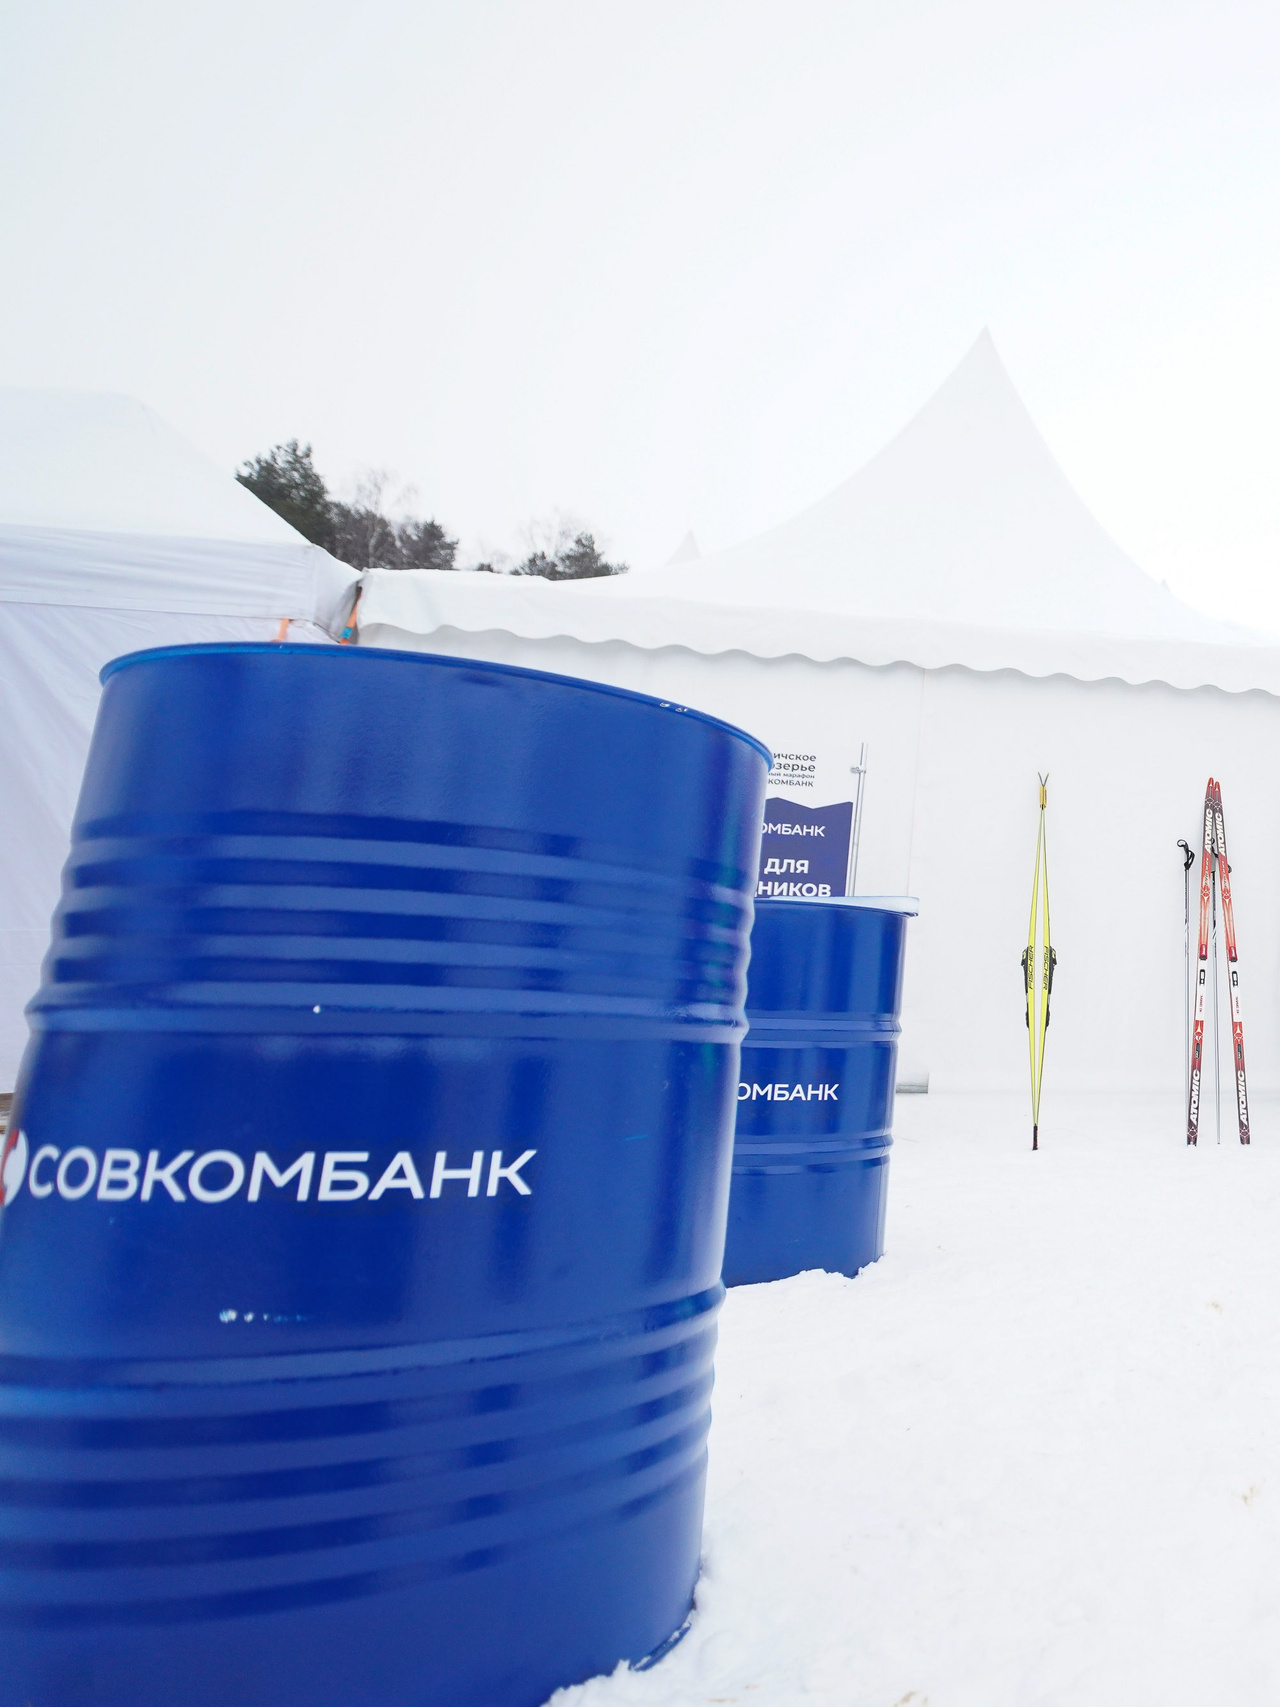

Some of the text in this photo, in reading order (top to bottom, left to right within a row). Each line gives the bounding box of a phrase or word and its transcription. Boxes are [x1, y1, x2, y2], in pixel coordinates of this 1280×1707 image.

[1204, 808, 1213, 855] ATOMIC
[1214, 812, 1226, 857] ATOMIC
[754, 881, 832, 897] НИКОВ
[763, 857, 809, 876] ДЛЯ
[1189, 1069, 1200, 1126] ATOMIC
[1238, 1069, 1248, 1126] ATOMIC
[28, 1143, 538, 1203] СОВКОМБАНК
